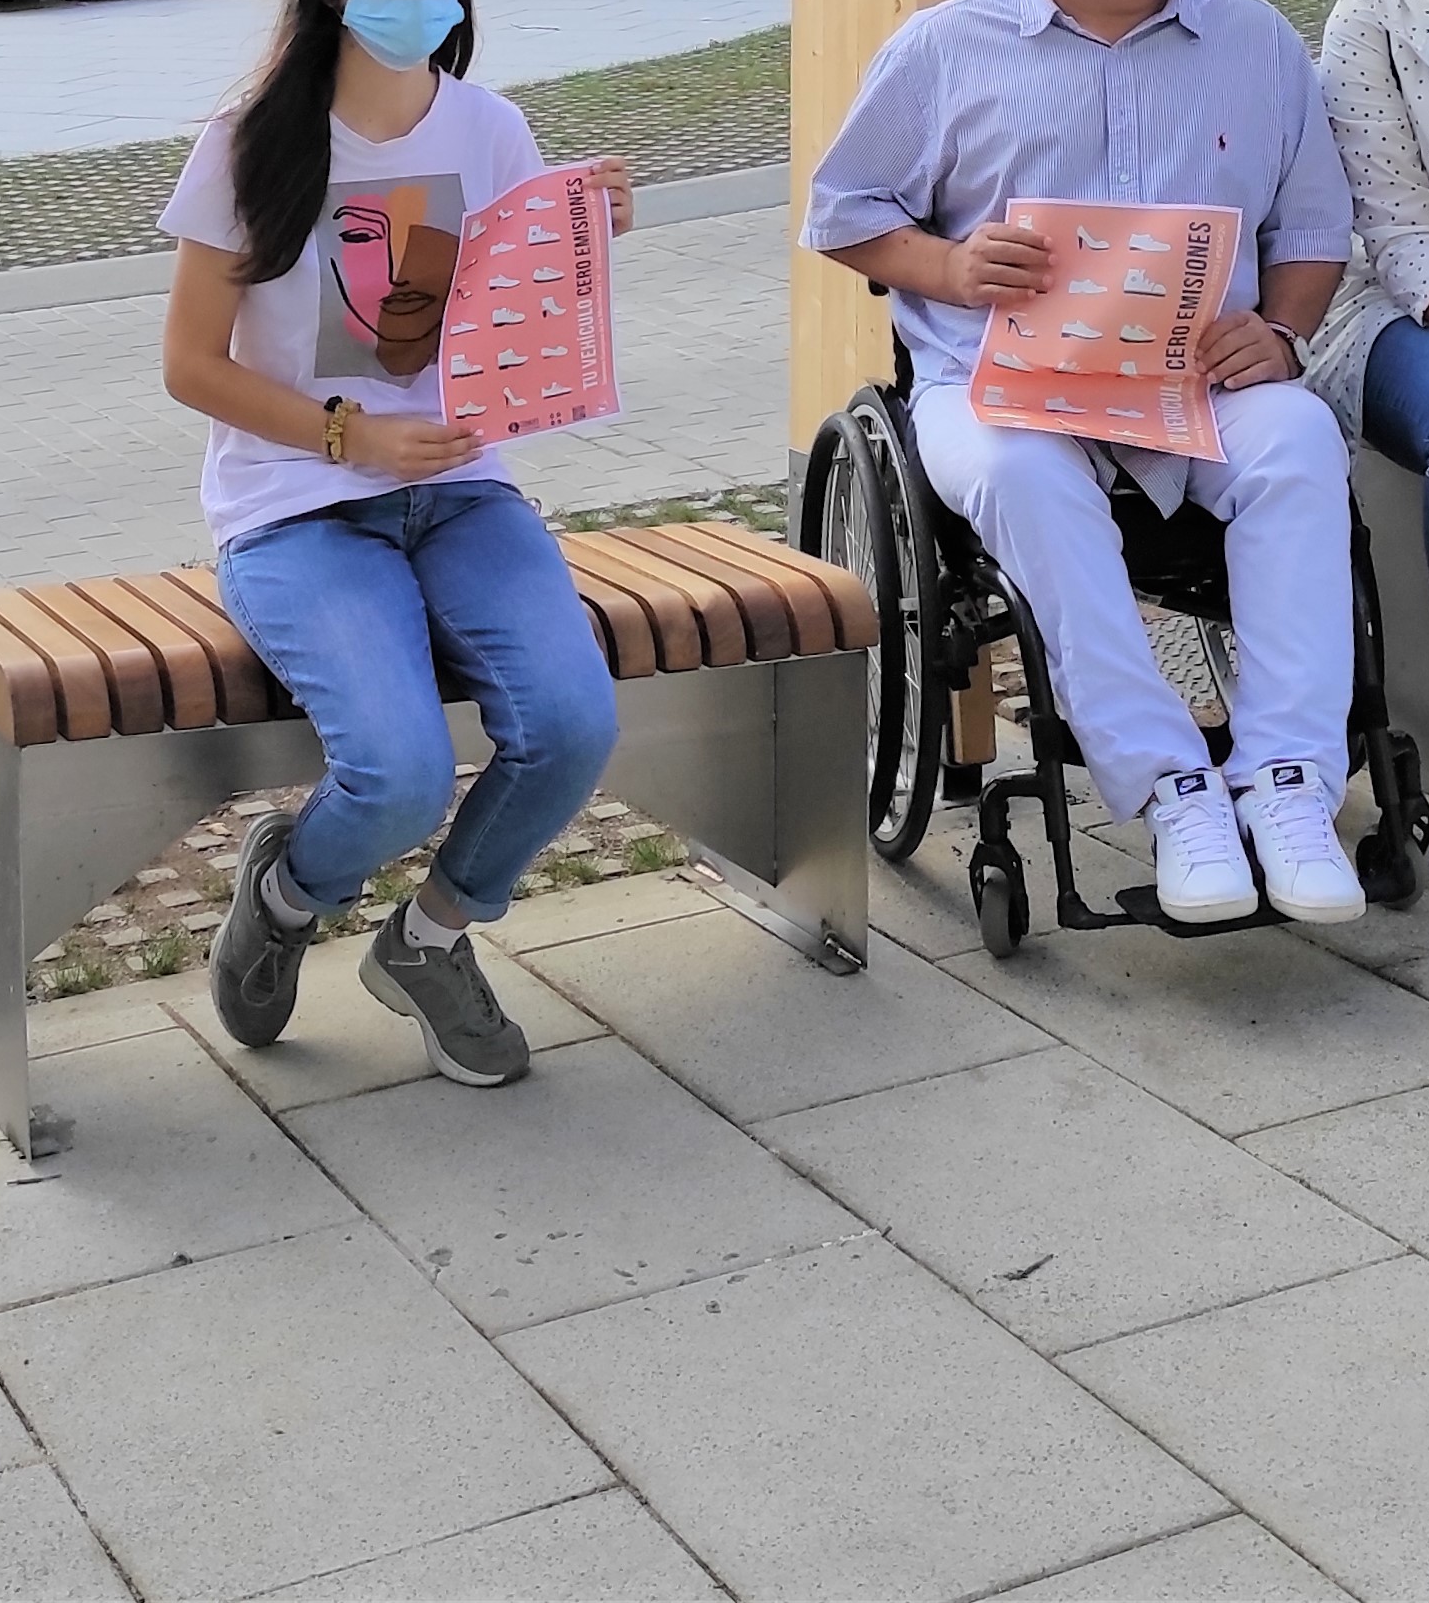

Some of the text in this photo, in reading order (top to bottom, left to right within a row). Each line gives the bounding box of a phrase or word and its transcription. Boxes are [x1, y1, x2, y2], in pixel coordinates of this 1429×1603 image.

[566, 176, 598, 392] TU VEHÍCULO CERO EMISIONES
[1165, 324, 1189, 371] CERO
[1179, 221, 1212, 320] EMISIONES
